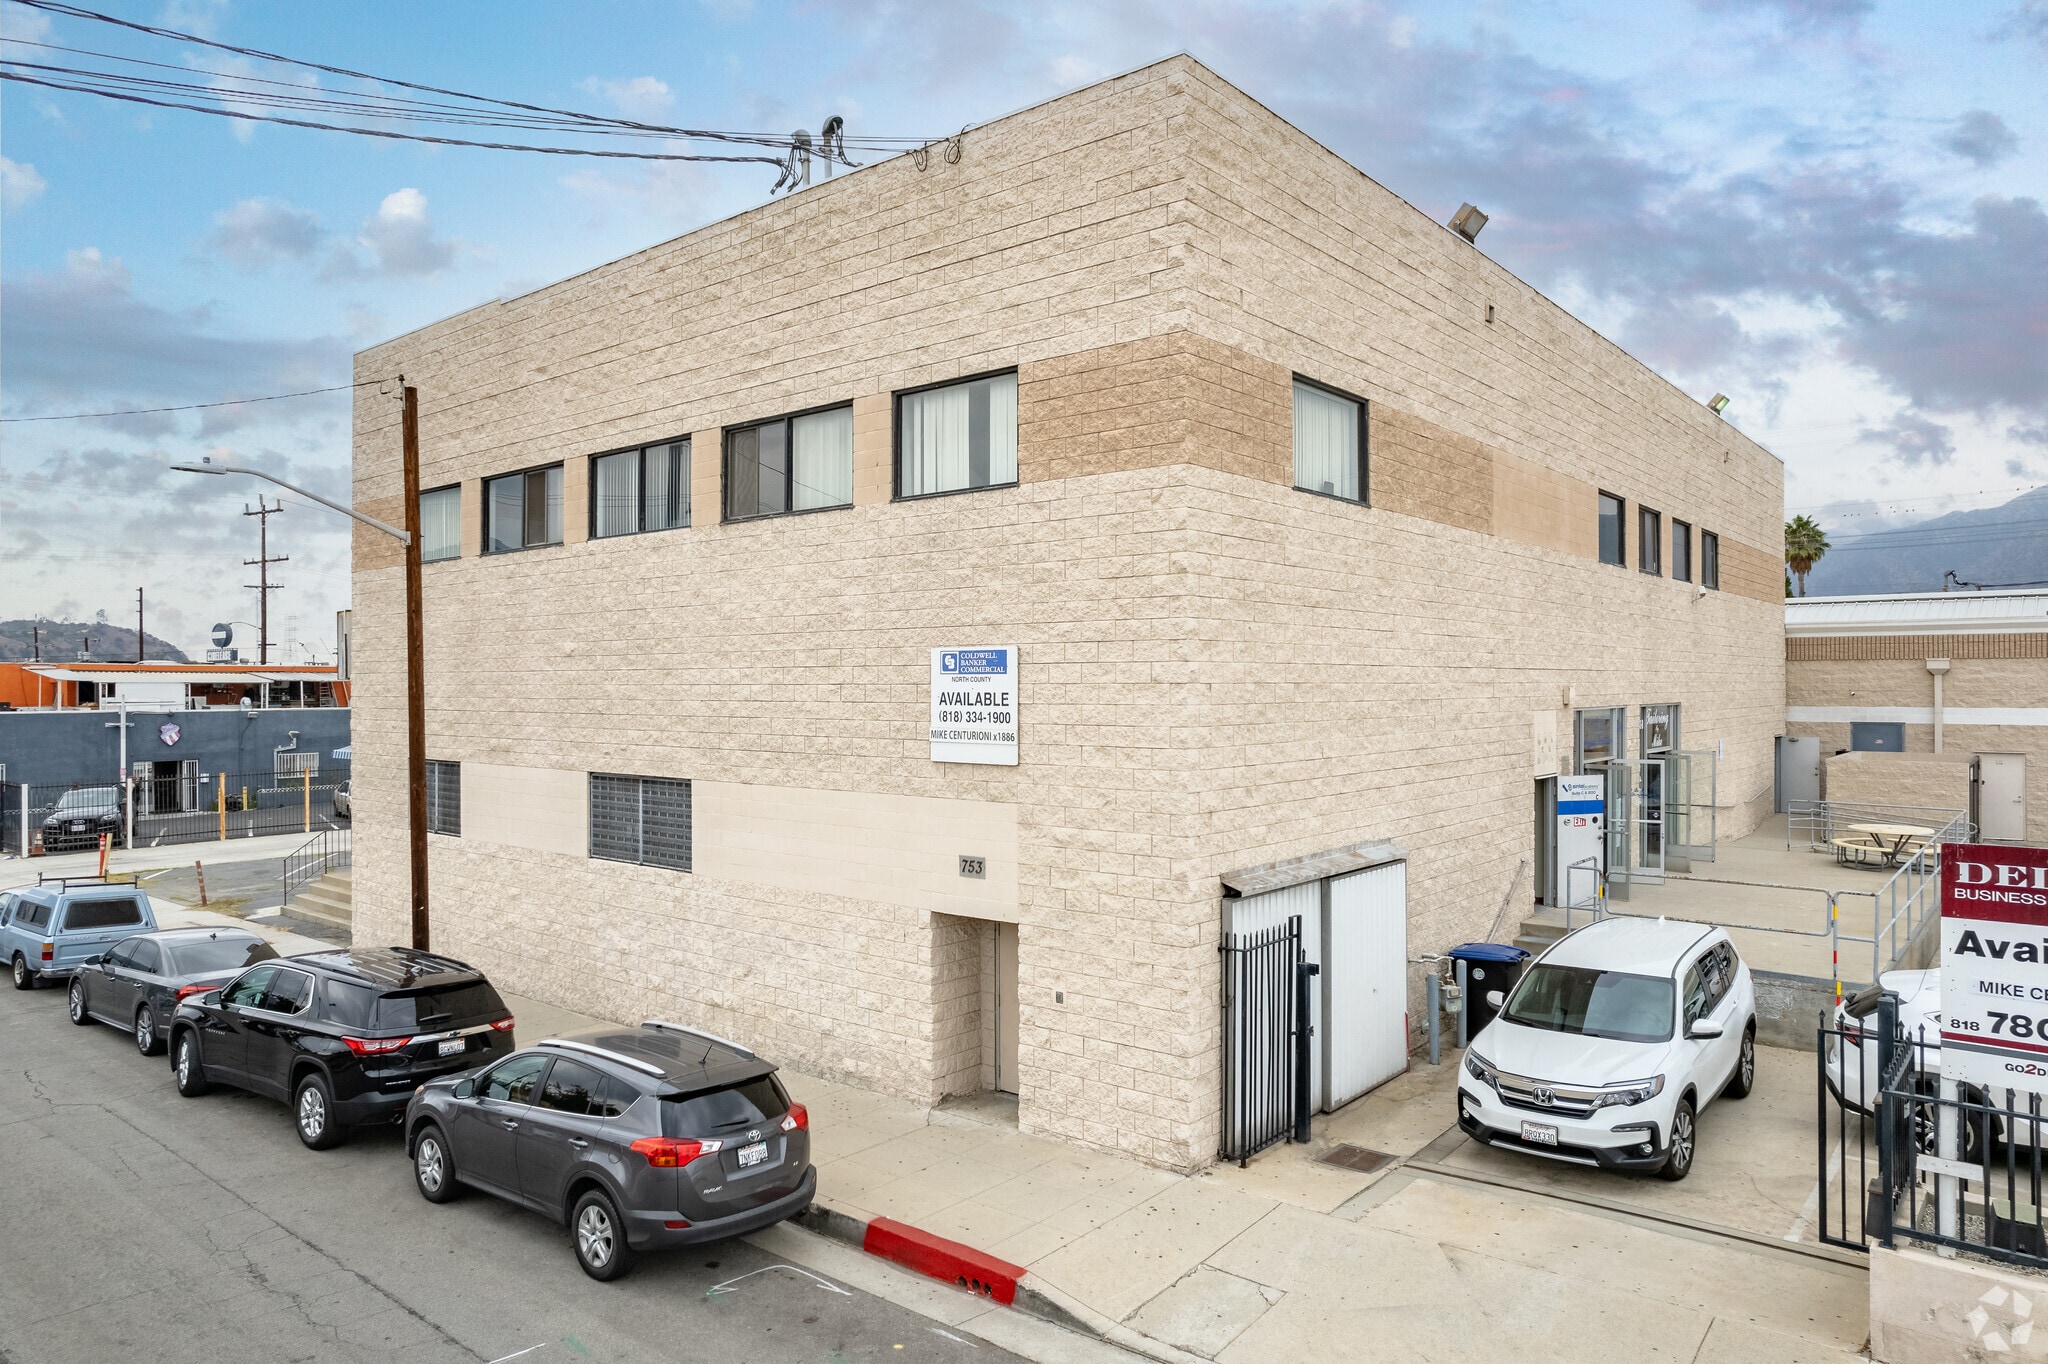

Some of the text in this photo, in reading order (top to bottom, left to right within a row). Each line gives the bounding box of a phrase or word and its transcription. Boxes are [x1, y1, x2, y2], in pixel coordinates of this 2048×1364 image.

[939, 692, 1009, 706] AVAILABLE
[939, 711, 1011, 724] (818) 334-1900
[931, 730, 1015, 742] MIKE CENTURIONI x1886
[962, 859, 983, 874] 753
[1954, 888, 2047, 906] BUSINESS
[1980, 981, 2024, 998] MIKE
[1951, 1019, 1980, 1031] 818
